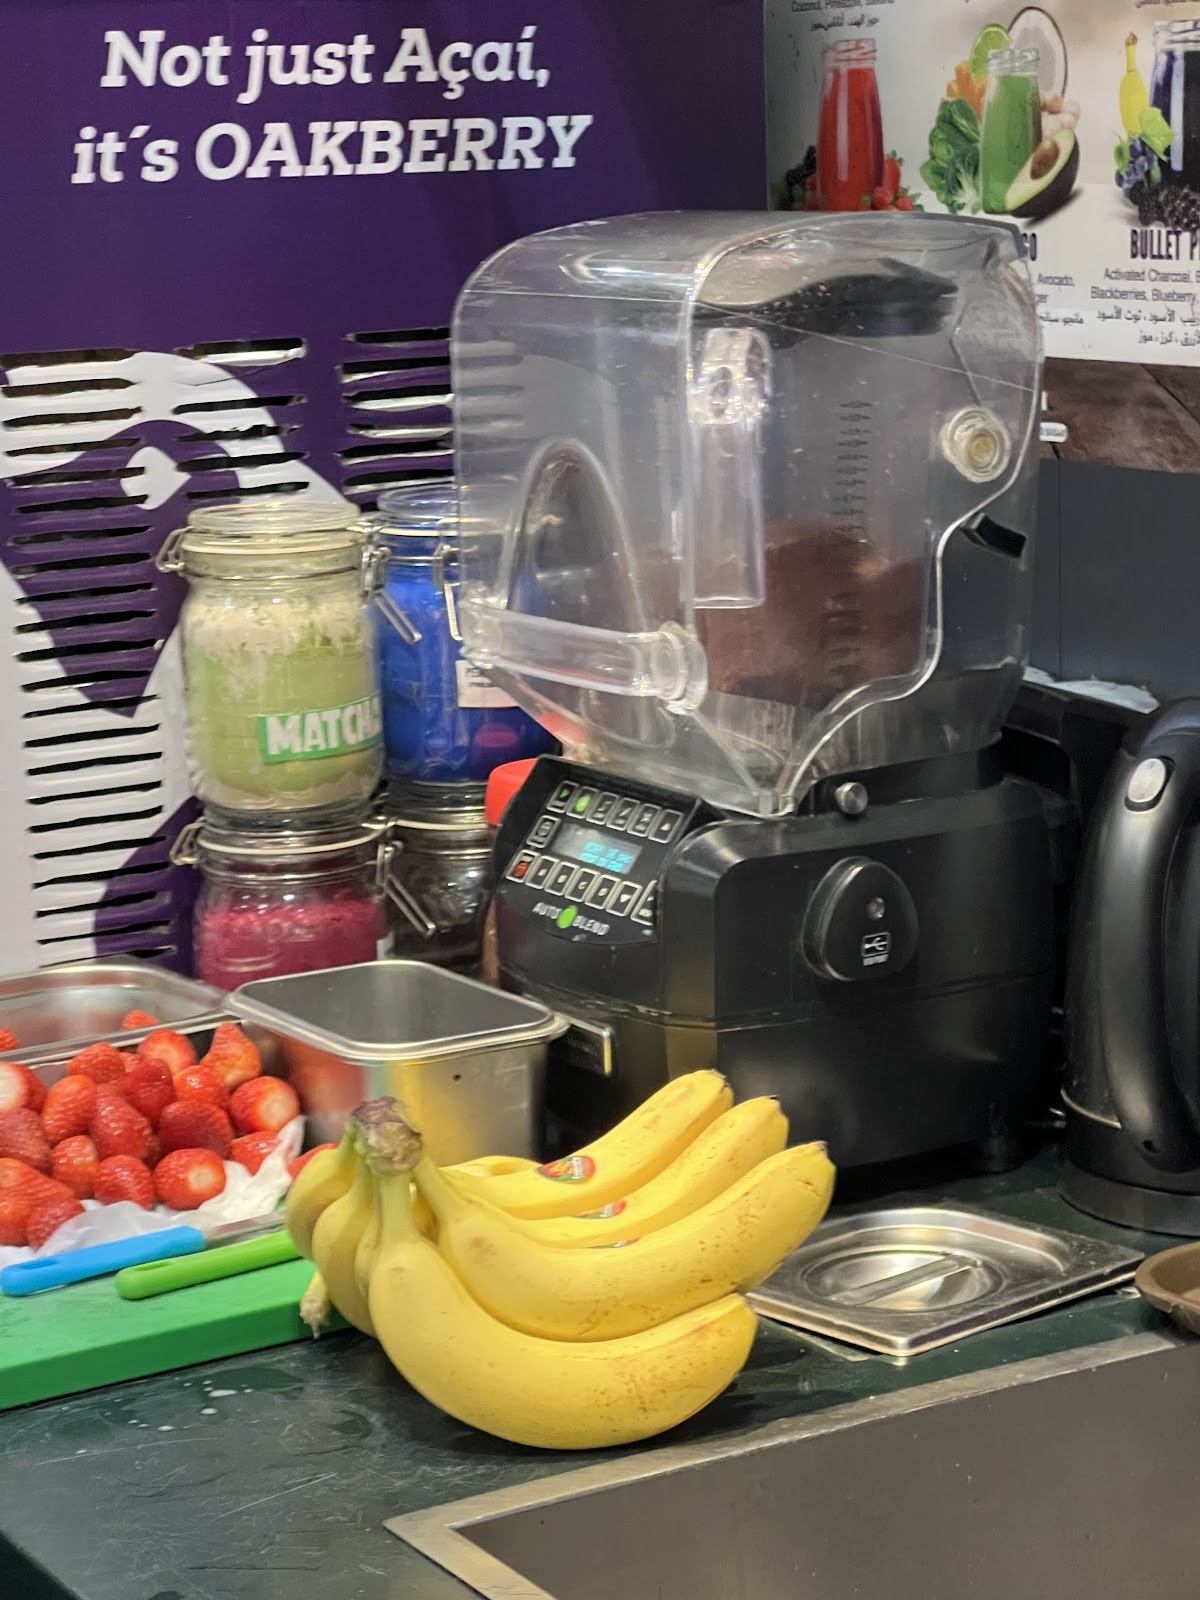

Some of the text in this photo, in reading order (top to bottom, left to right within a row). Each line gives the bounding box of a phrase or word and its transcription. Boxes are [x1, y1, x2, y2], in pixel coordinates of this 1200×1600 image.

[100, 25, 551, 104] Not just Açaí,
[195, 114, 593, 182] OAKBERRY
[1130, 229, 1181, 261] BULLET
[1104, 267, 1145, 282] Activated
[573, 915, 610, 936] BLEND
